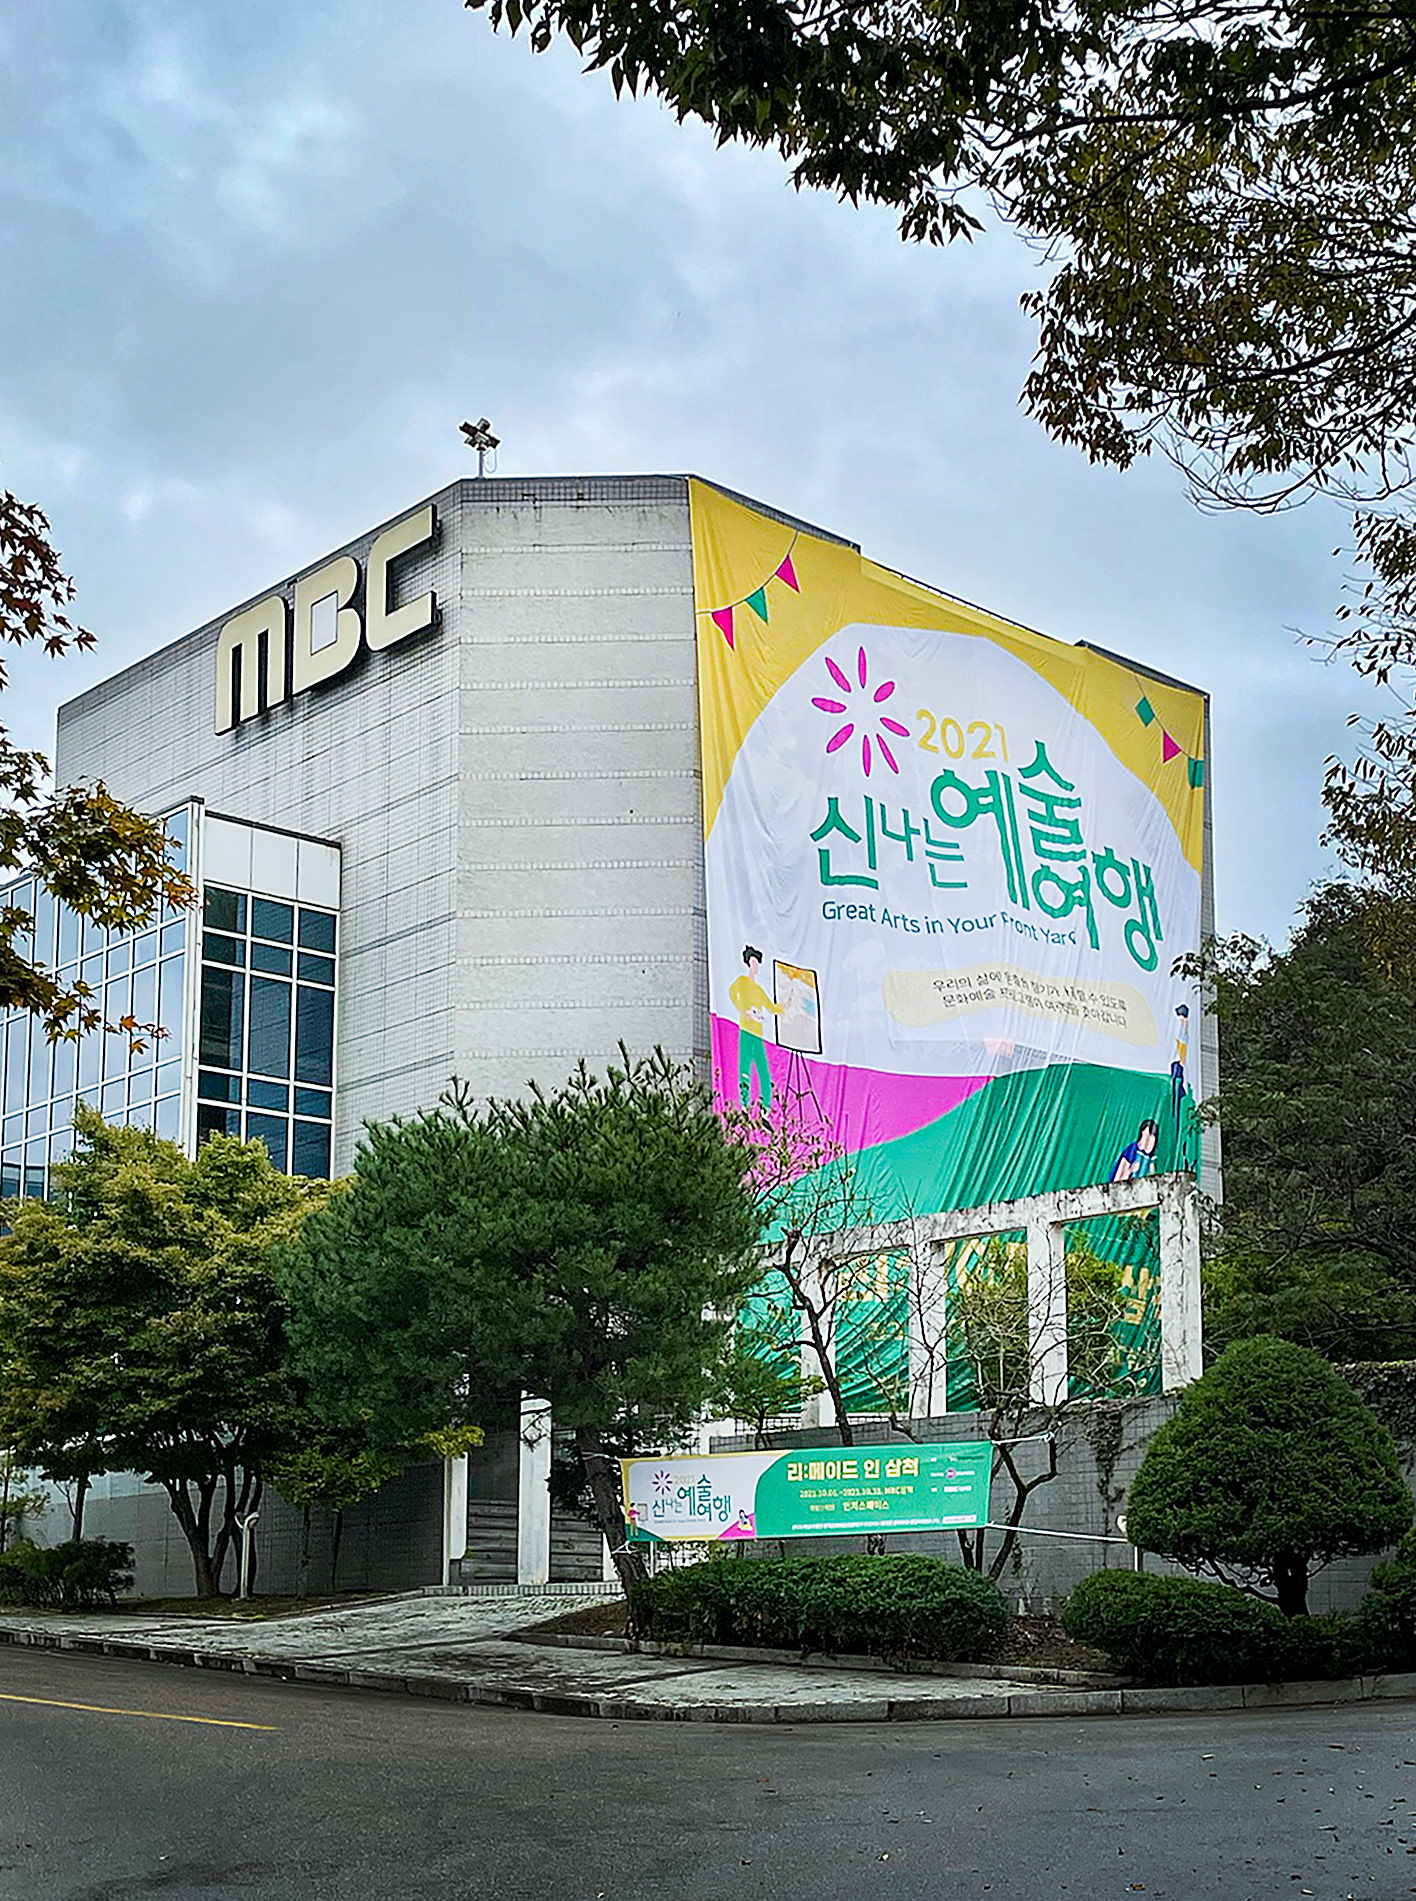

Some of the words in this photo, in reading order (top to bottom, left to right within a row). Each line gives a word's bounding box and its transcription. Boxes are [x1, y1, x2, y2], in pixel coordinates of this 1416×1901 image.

[215, 503, 437, 736] MBC
[916, 709, 1009, 763] 2021
[810, 794, 968, 890] 신나는
[822, 901, 876, 922] Great
[881, 908, 921, 933] Arts
[925, 916, 944, 934] in
[947, 912, 997, 934] Your
[1001, 911, 1038, 941] Front
[933, 976, 972, 992] 우리의
[976, 971, 1003, 986] 삶에
[942, 988, 996, 1008] 문화예술
[674, 1475, 695, 1484] 2021
[787, 1460, 859, 1482] 리:메이드
[863, 1459, 880, 1479] 인
[884, 1457, 920, 1478] 삼척
[652, 1497, 682, 1518] 신나는
